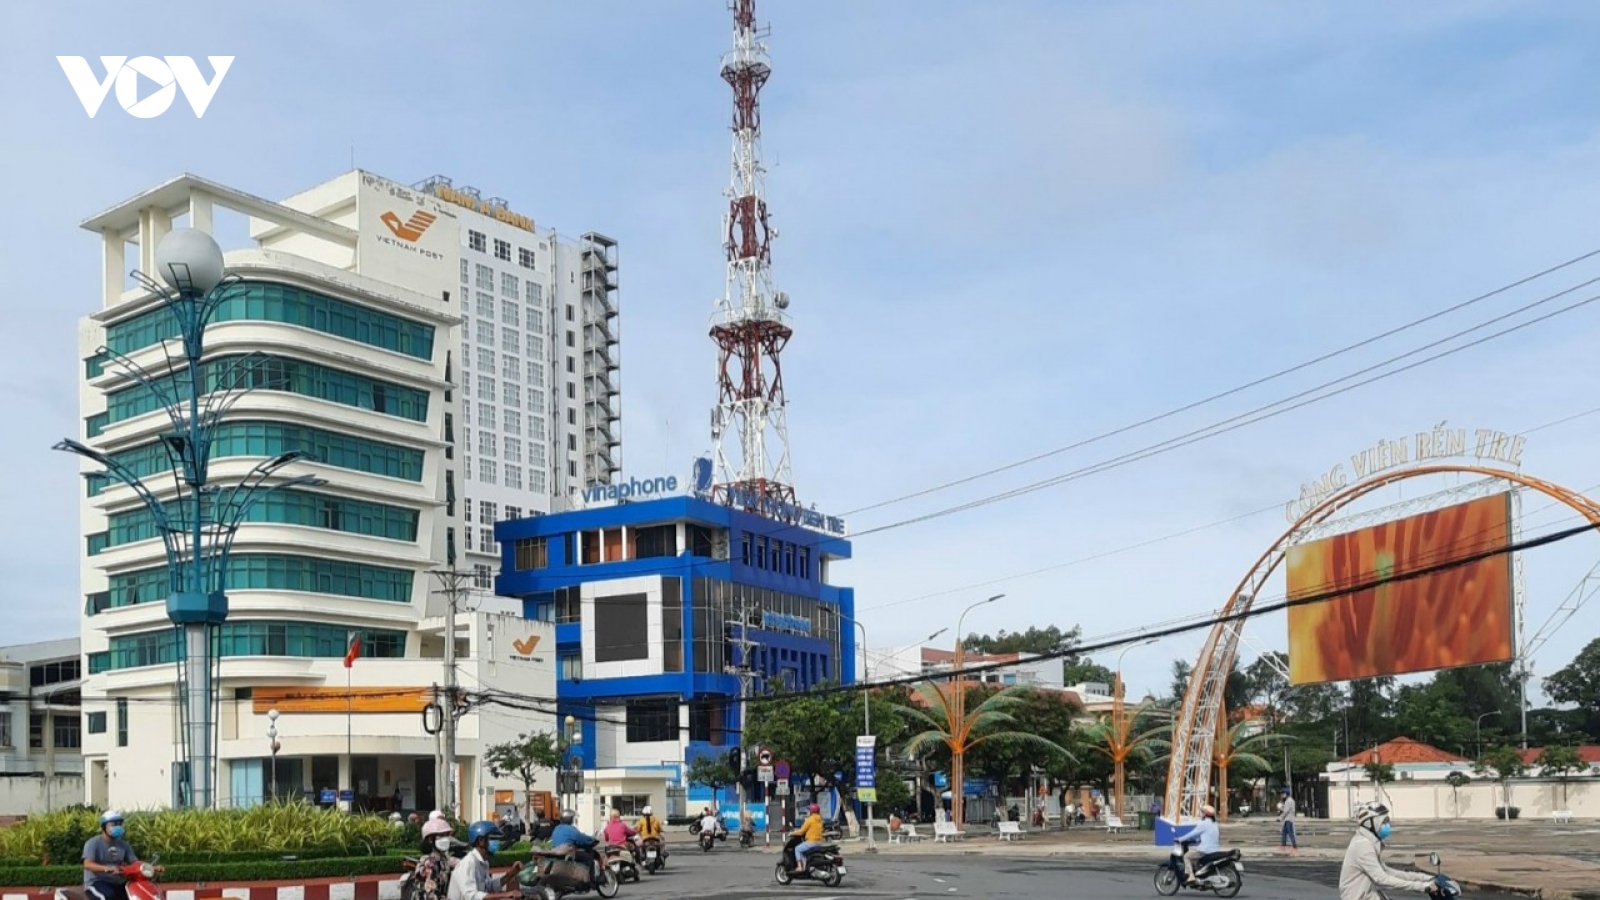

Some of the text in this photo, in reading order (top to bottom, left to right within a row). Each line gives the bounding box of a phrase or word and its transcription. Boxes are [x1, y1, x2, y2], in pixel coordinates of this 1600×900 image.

[436, 184, 475, 211] NAM
[495, 204, 535, 233] BANK
[376, 235, 443, 260] VIETNAM POST
[1351, 438, 1408, 478] VIÊN
[1416, 420, 1466, 460] BẾN
[1475, 428, 1527, 466] TRE
[581, 474, 677, 504] vinaphone
